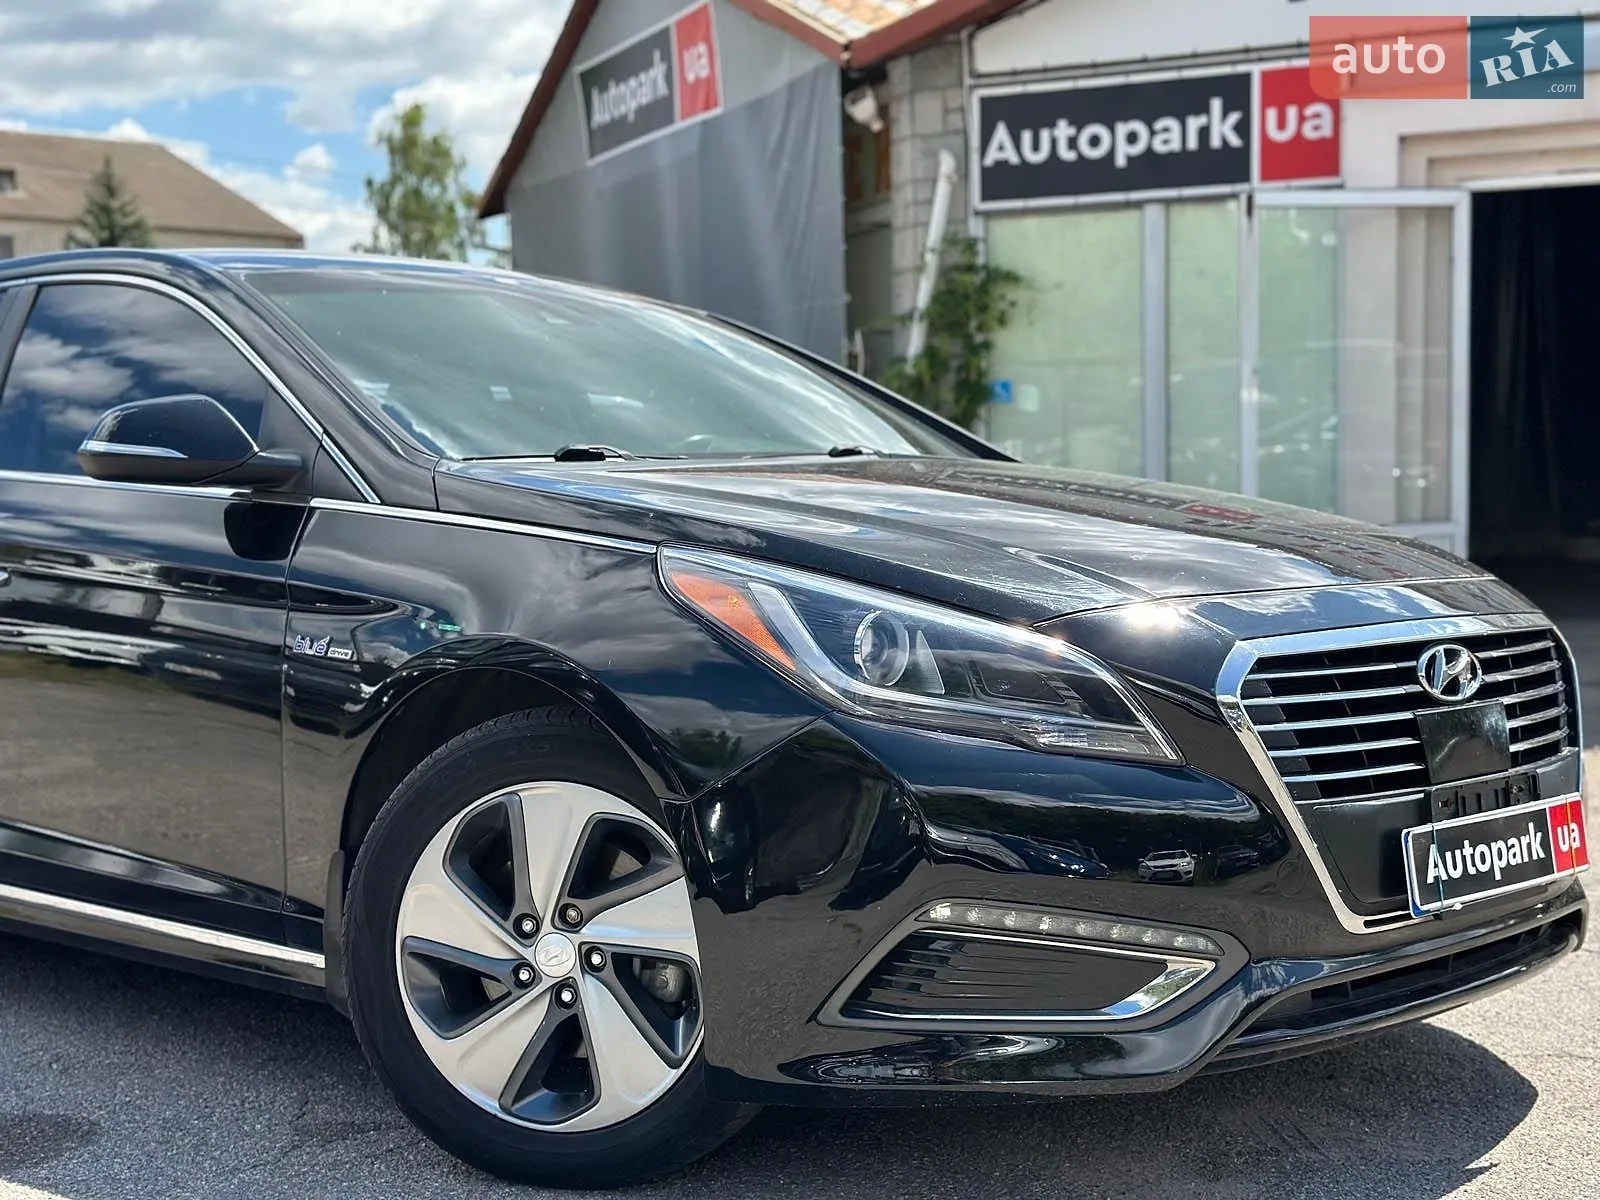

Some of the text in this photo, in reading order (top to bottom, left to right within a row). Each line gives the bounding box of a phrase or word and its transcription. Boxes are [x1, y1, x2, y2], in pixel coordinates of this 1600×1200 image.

[591, 49, 670, 130] Autopark
[982, 96, 1334, 169] Autopark ua
[1426, 821, 1581, 884] Autopark ua
